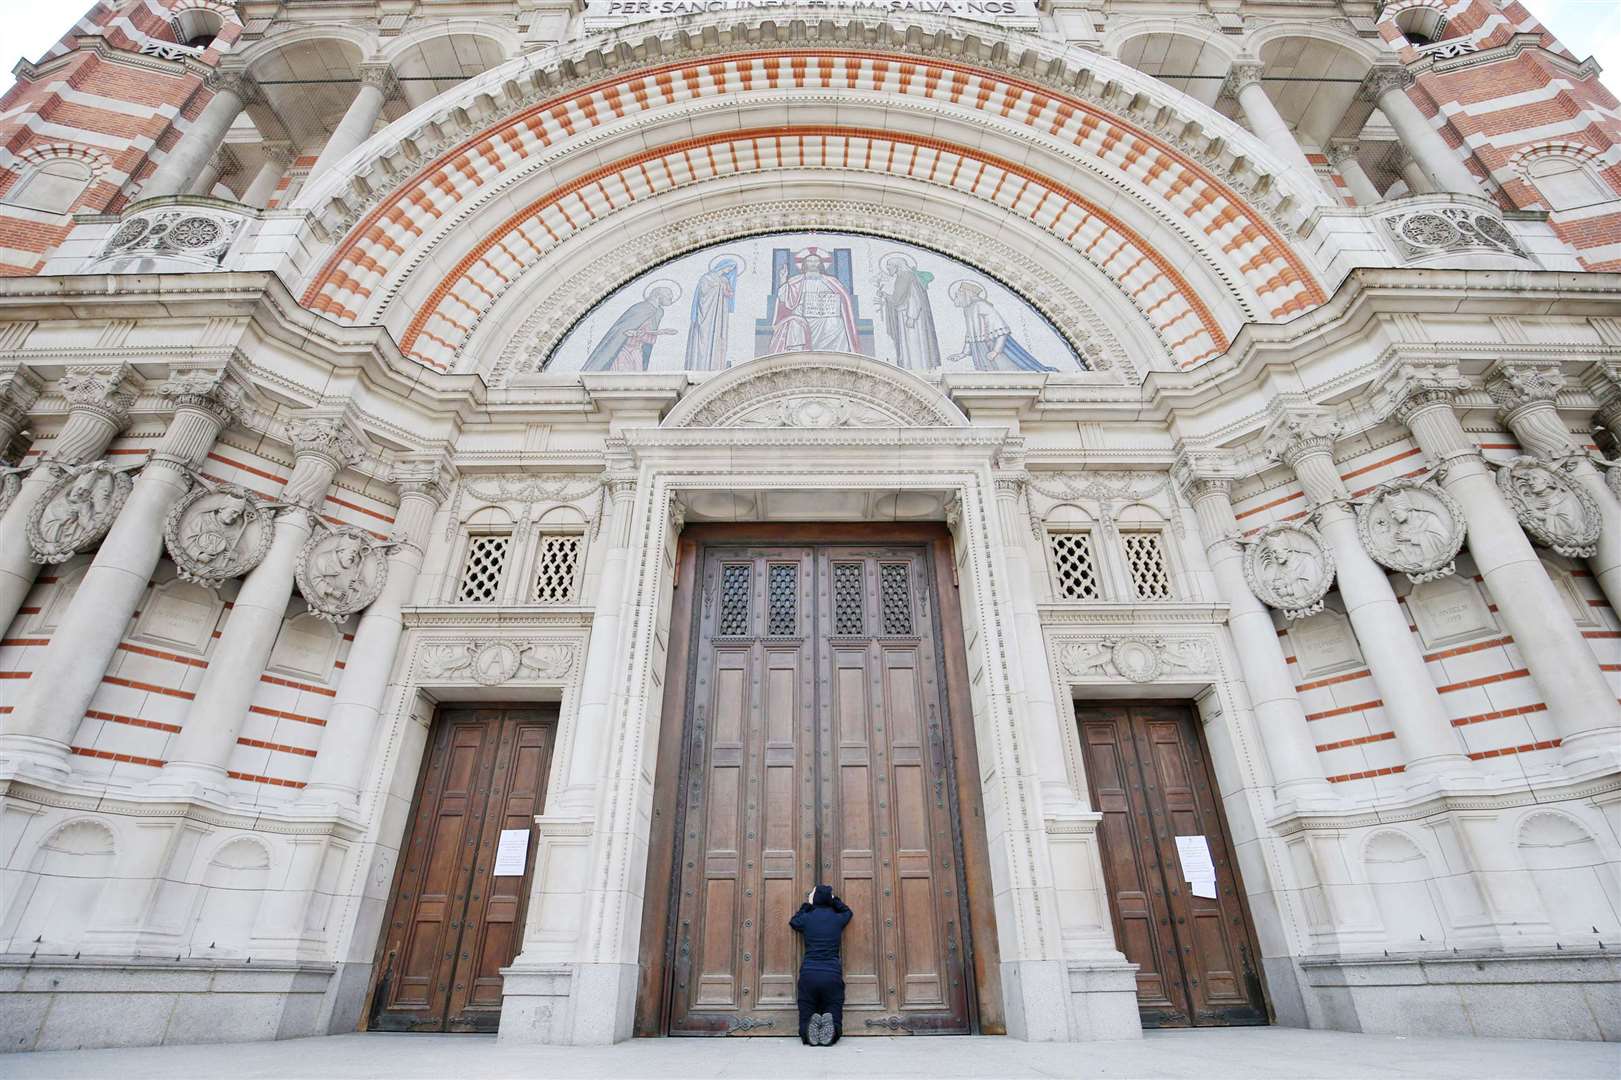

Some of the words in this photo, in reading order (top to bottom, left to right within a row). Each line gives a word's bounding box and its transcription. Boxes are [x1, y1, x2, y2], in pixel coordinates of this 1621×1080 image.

[608, 2, 651, 14] PER
[888, 1, 957, 13] SALVA
[967, 2, 1016, 13] NOS
[480, 648, 505, 674] A
